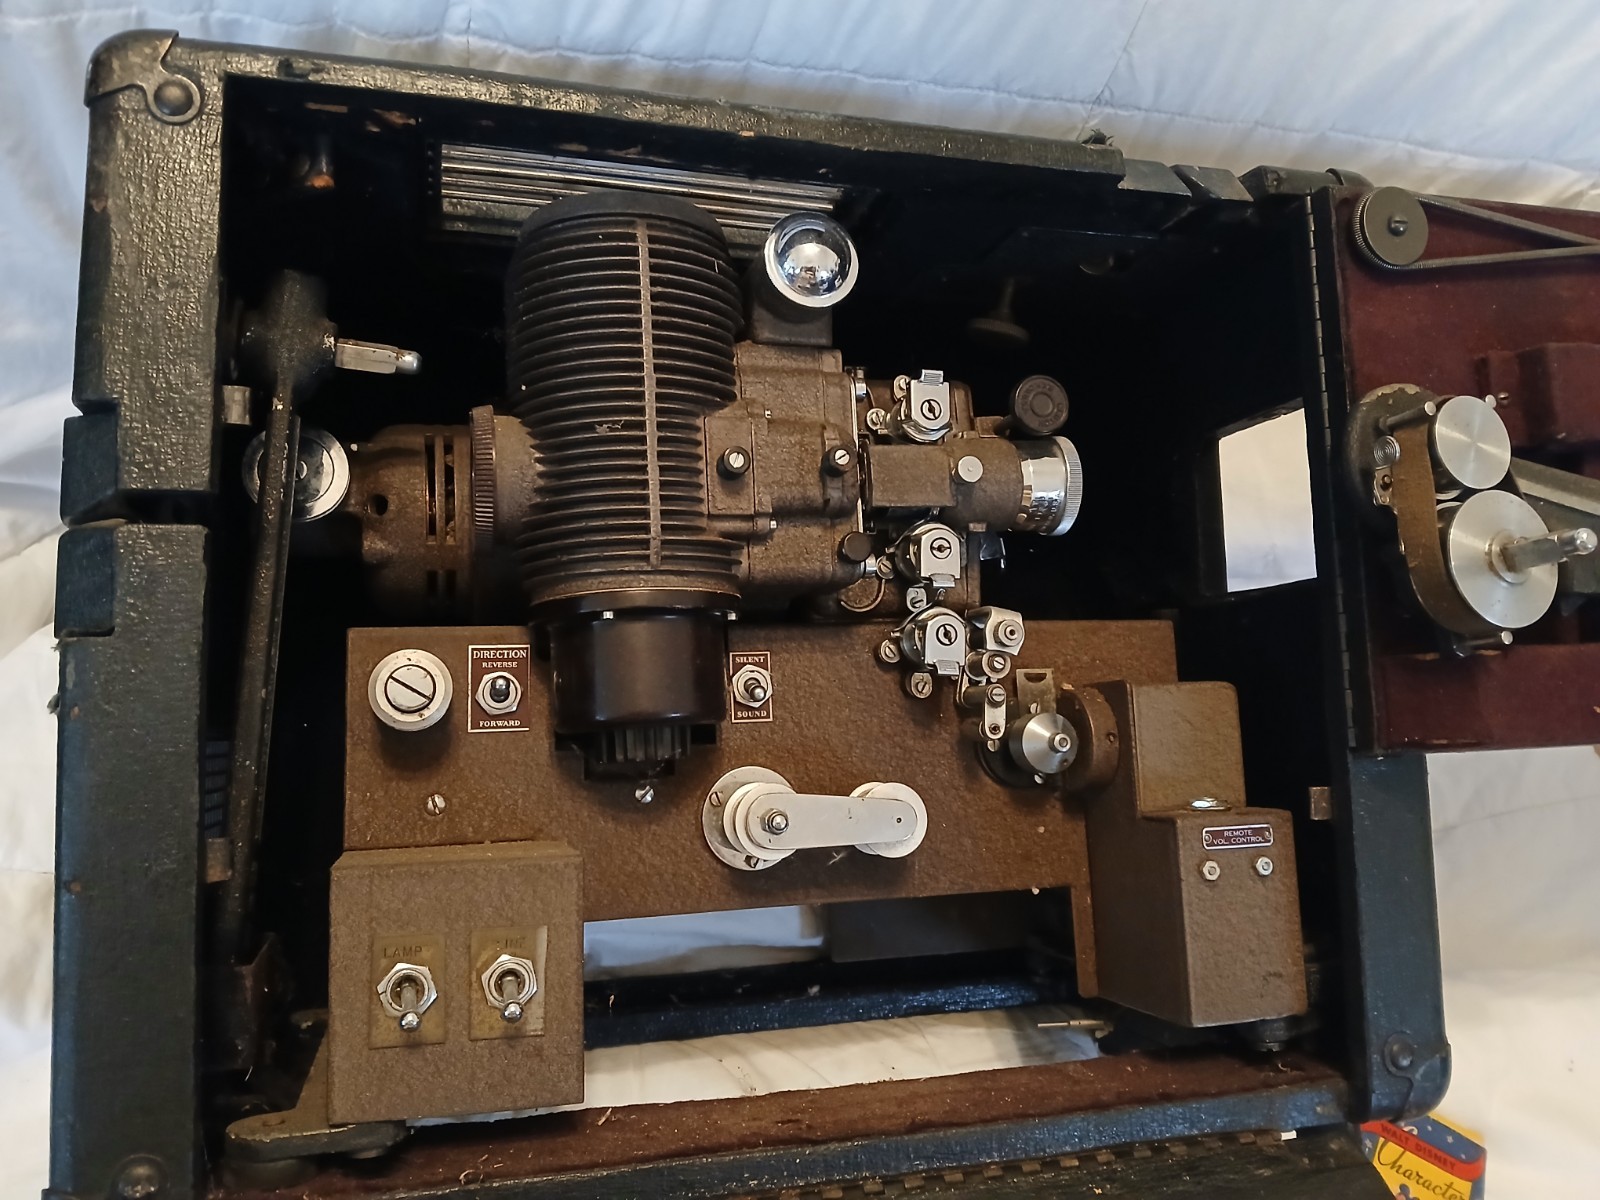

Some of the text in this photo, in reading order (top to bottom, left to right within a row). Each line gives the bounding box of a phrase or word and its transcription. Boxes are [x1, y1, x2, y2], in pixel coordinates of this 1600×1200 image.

[473, 649, 527, 659] DIRECTION
[737, 710, 767, 718] SOUND
[1223, 829, 1253, 837] REMOTE
[1231, 836, 1265, 844] CONTROL
[383, 945, 423, 959] LAMP
[1380, 1122, 1457, 1171] WALT DISNEY
